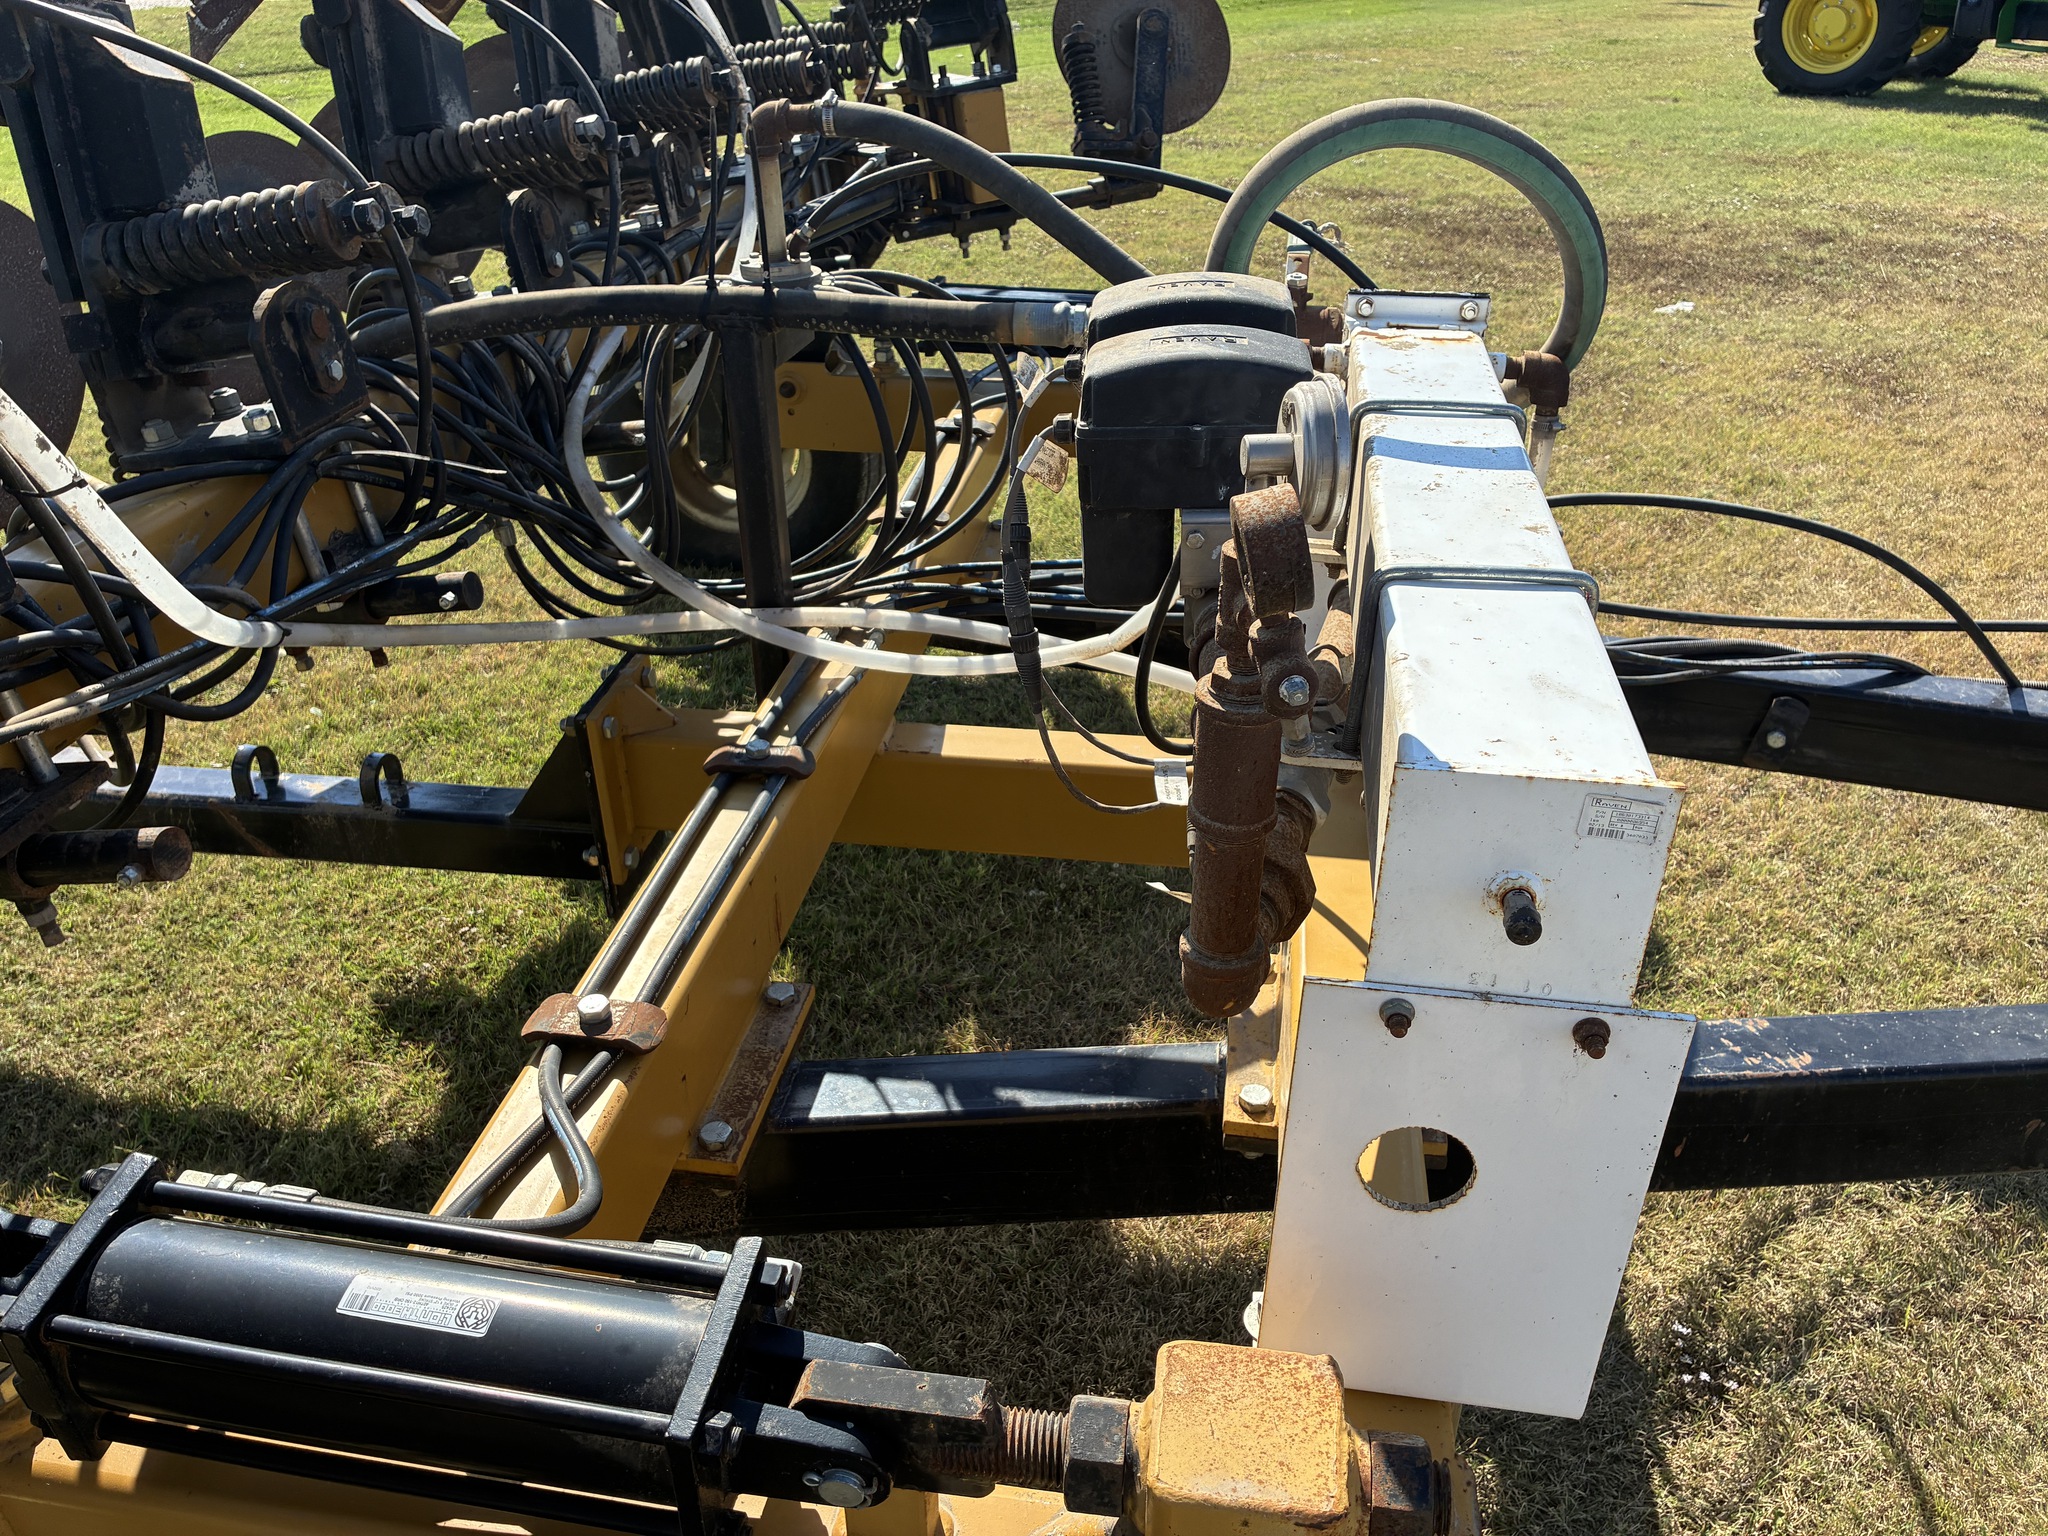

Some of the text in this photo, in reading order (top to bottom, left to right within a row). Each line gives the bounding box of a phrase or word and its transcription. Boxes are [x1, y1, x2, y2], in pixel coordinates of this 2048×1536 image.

[1157, 281, 1225, 290] RAVEN
[1161, 336, 1237, 345] RAVEN
[1594, 798, 1628, 810] RAVEN
